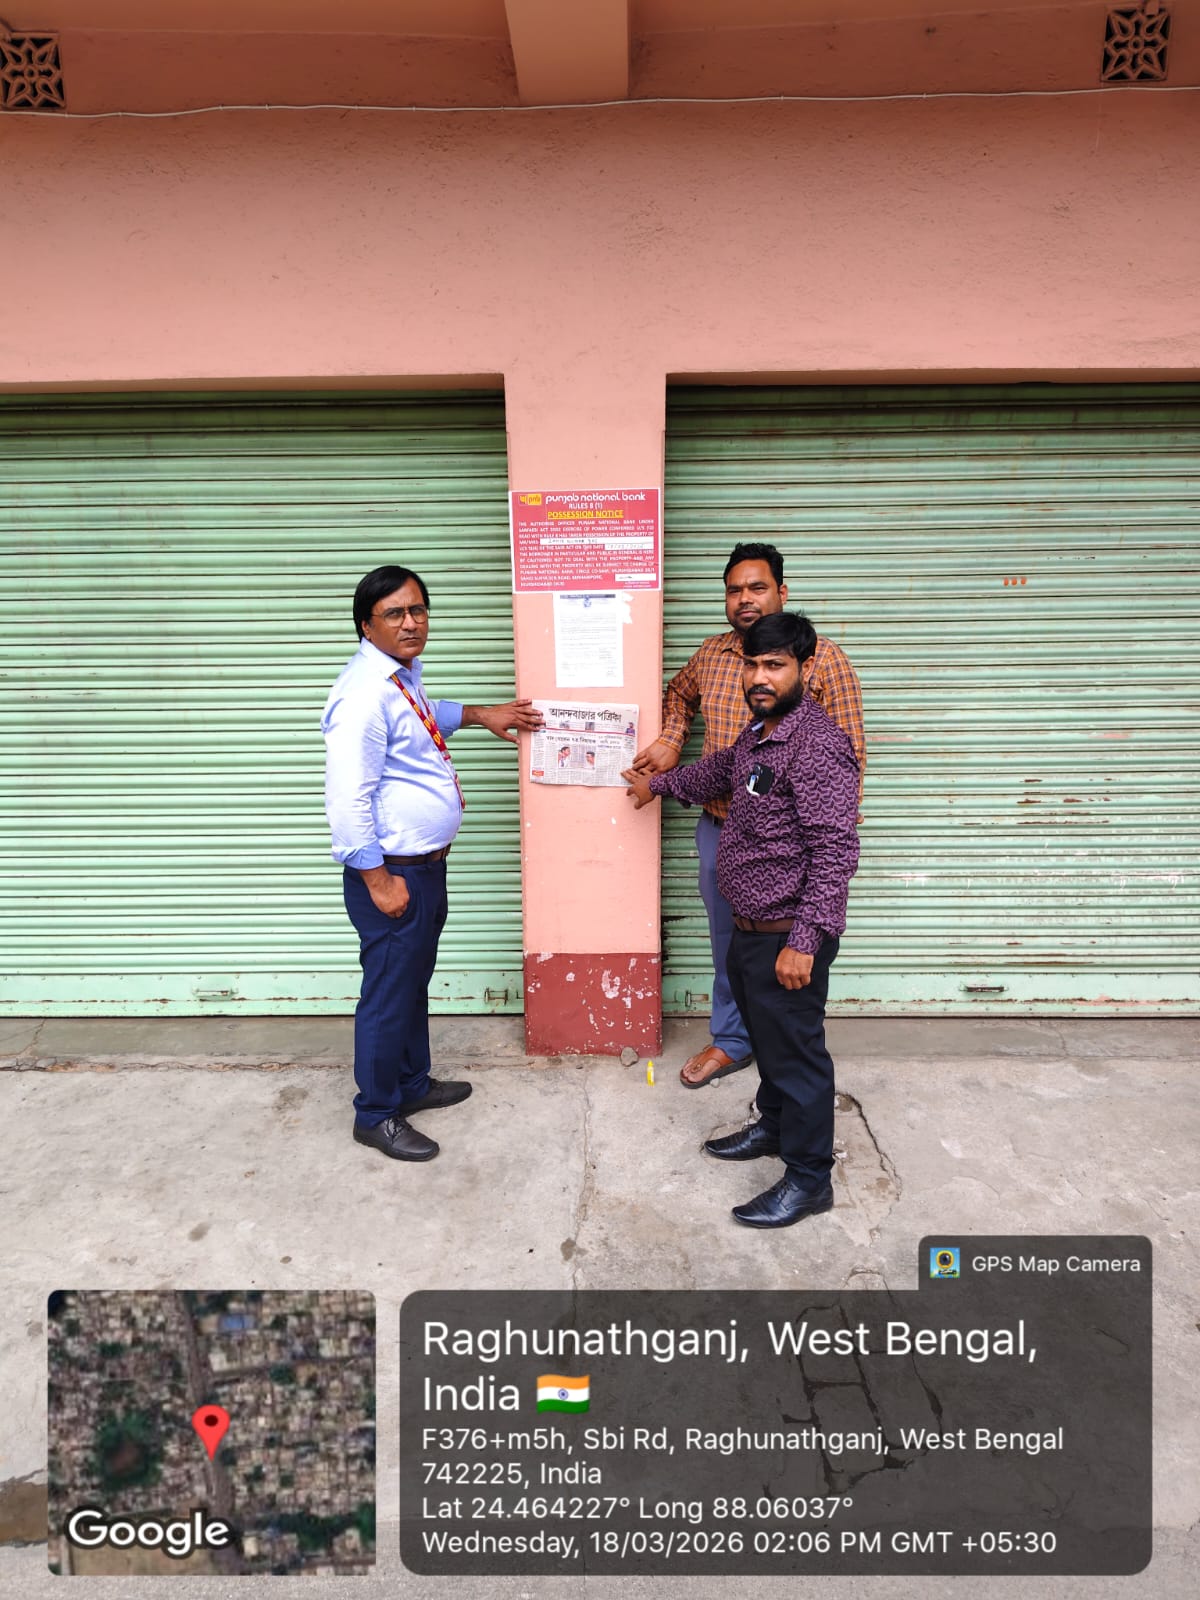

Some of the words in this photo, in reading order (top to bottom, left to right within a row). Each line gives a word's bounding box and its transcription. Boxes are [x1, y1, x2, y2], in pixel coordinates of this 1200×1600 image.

[545, 493, 579, 505] punjab
[580, 491, 620, 501] national
[621, 491, 646, 501] bank
[548, 511, 594, 519] POSSESSION
[595, 510, 624, 518] NOTICE
[549, 708, 596, 720] আনন্দবাজার
[597, 709, 622, 722] পত্রিকা
